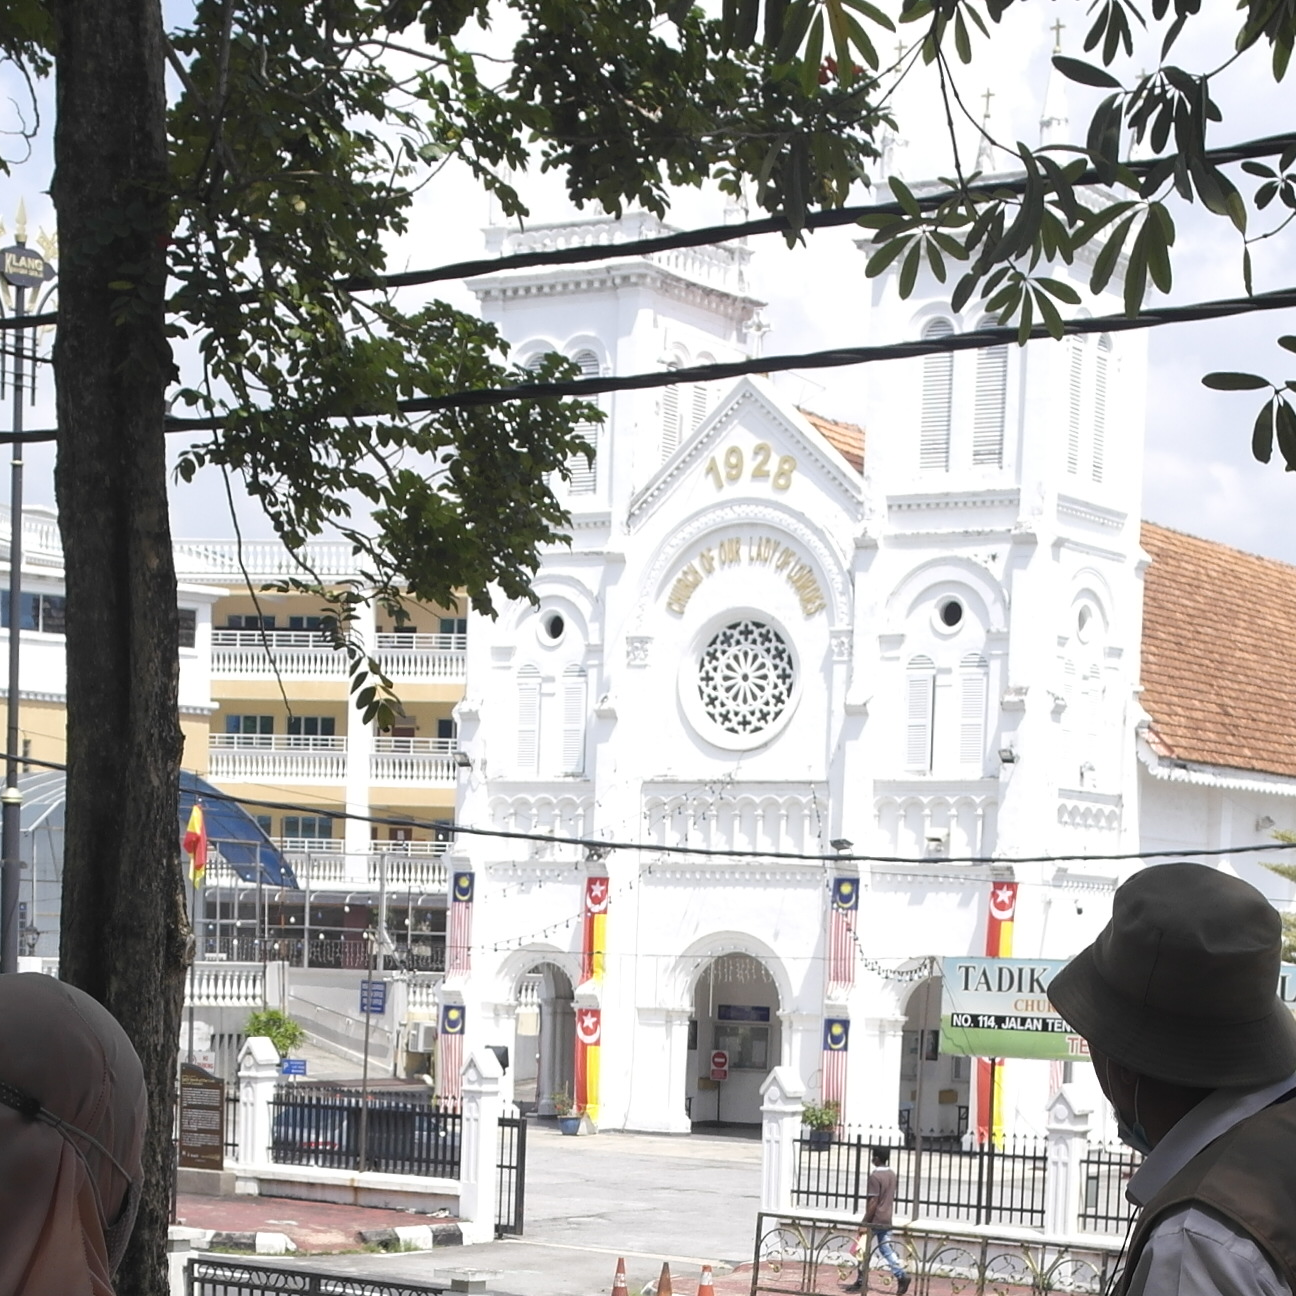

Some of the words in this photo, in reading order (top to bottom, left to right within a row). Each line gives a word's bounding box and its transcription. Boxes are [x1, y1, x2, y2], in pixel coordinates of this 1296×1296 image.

[705, 441, 796, 491] 1928
[699, 547, 715, 575] OF
[719, 536, 741, 566] OUR
[749, 536, 780, 564] LADY
[775, 546, 797, 573] OF
[958, 964, 1047, 994] TADIK
[1013, 999, 1057, 1013] CHUR
[952, 1014, 974, 1027] NO.
[977, 1015, 998, 1030] 114,
[1001, 1016, 1043, 1031] JALAN
[1046, 1018, 1077, 1033] TEN
